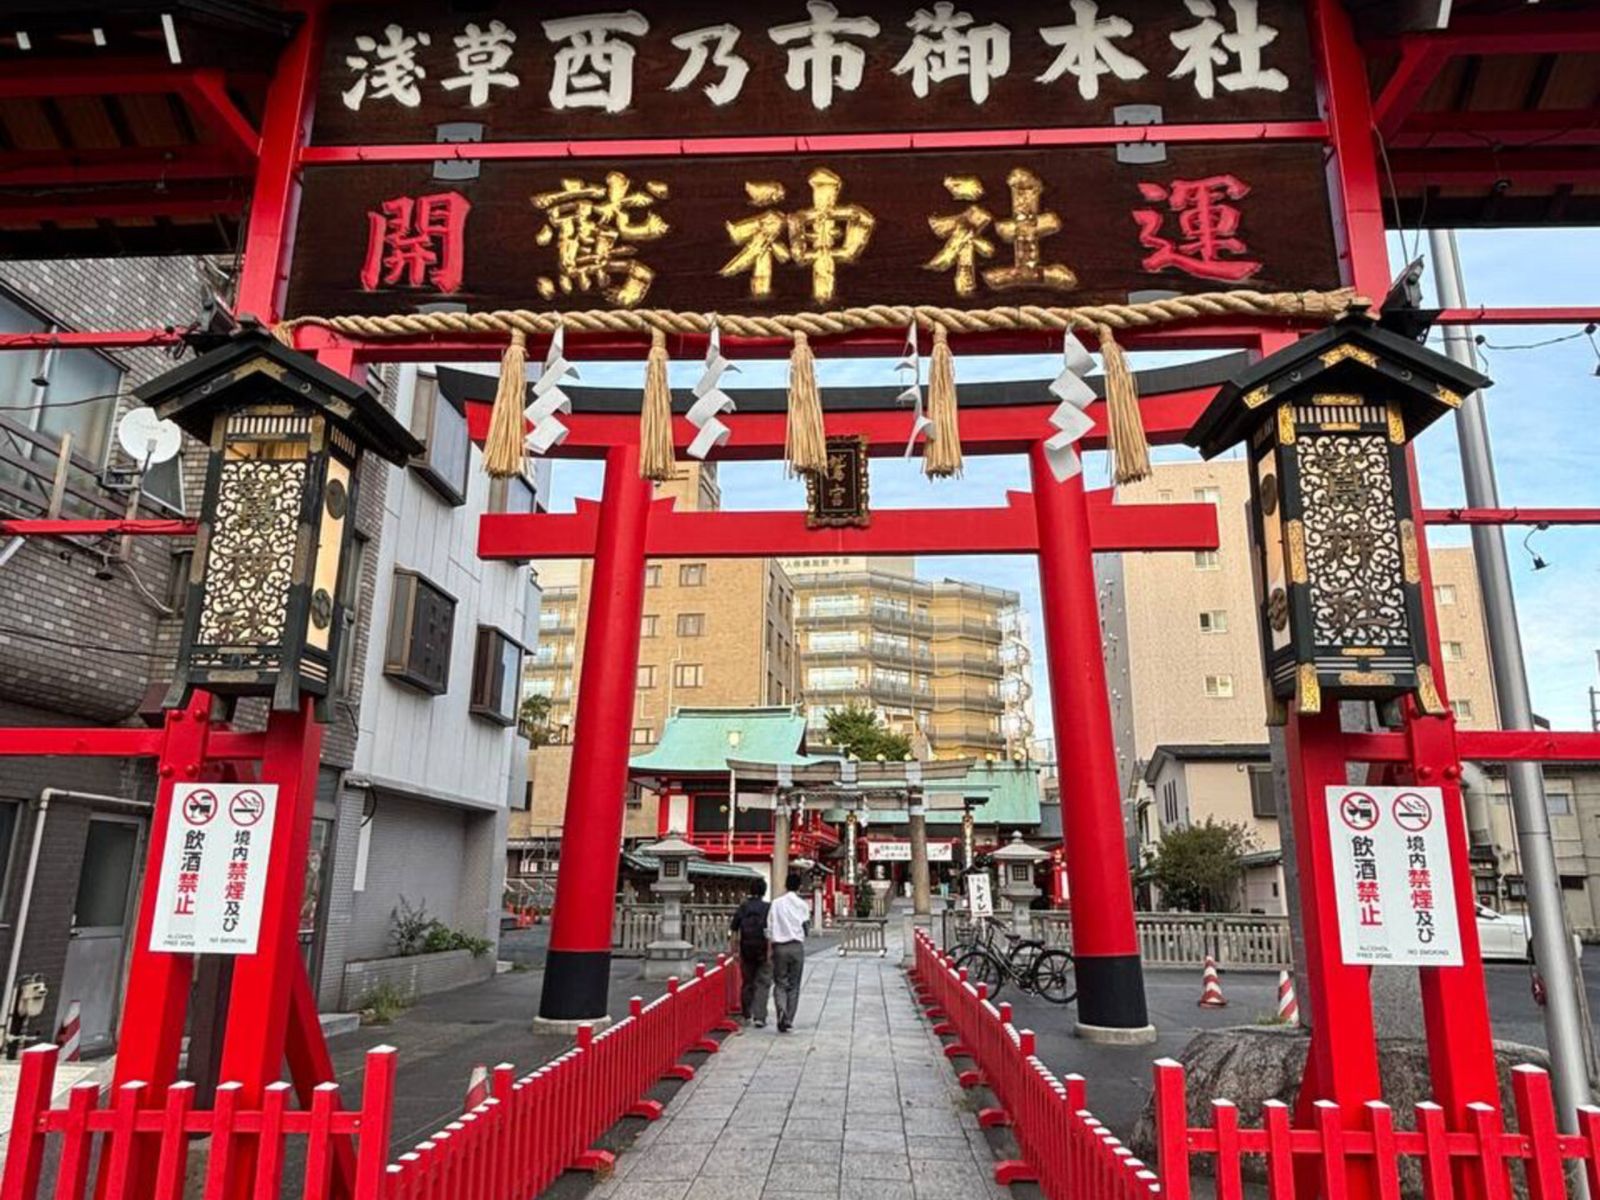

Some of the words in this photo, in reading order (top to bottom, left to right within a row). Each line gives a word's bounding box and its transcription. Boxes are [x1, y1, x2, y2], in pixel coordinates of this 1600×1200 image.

[174, 829, 206, 916] 飲酒禁止
[222, 829, 251, 933] 境内禁煙及び
[1350, 835, 1383, 927] 飲酒禁止
[1406, 835, 1436, 944] 境内禁煙及び
